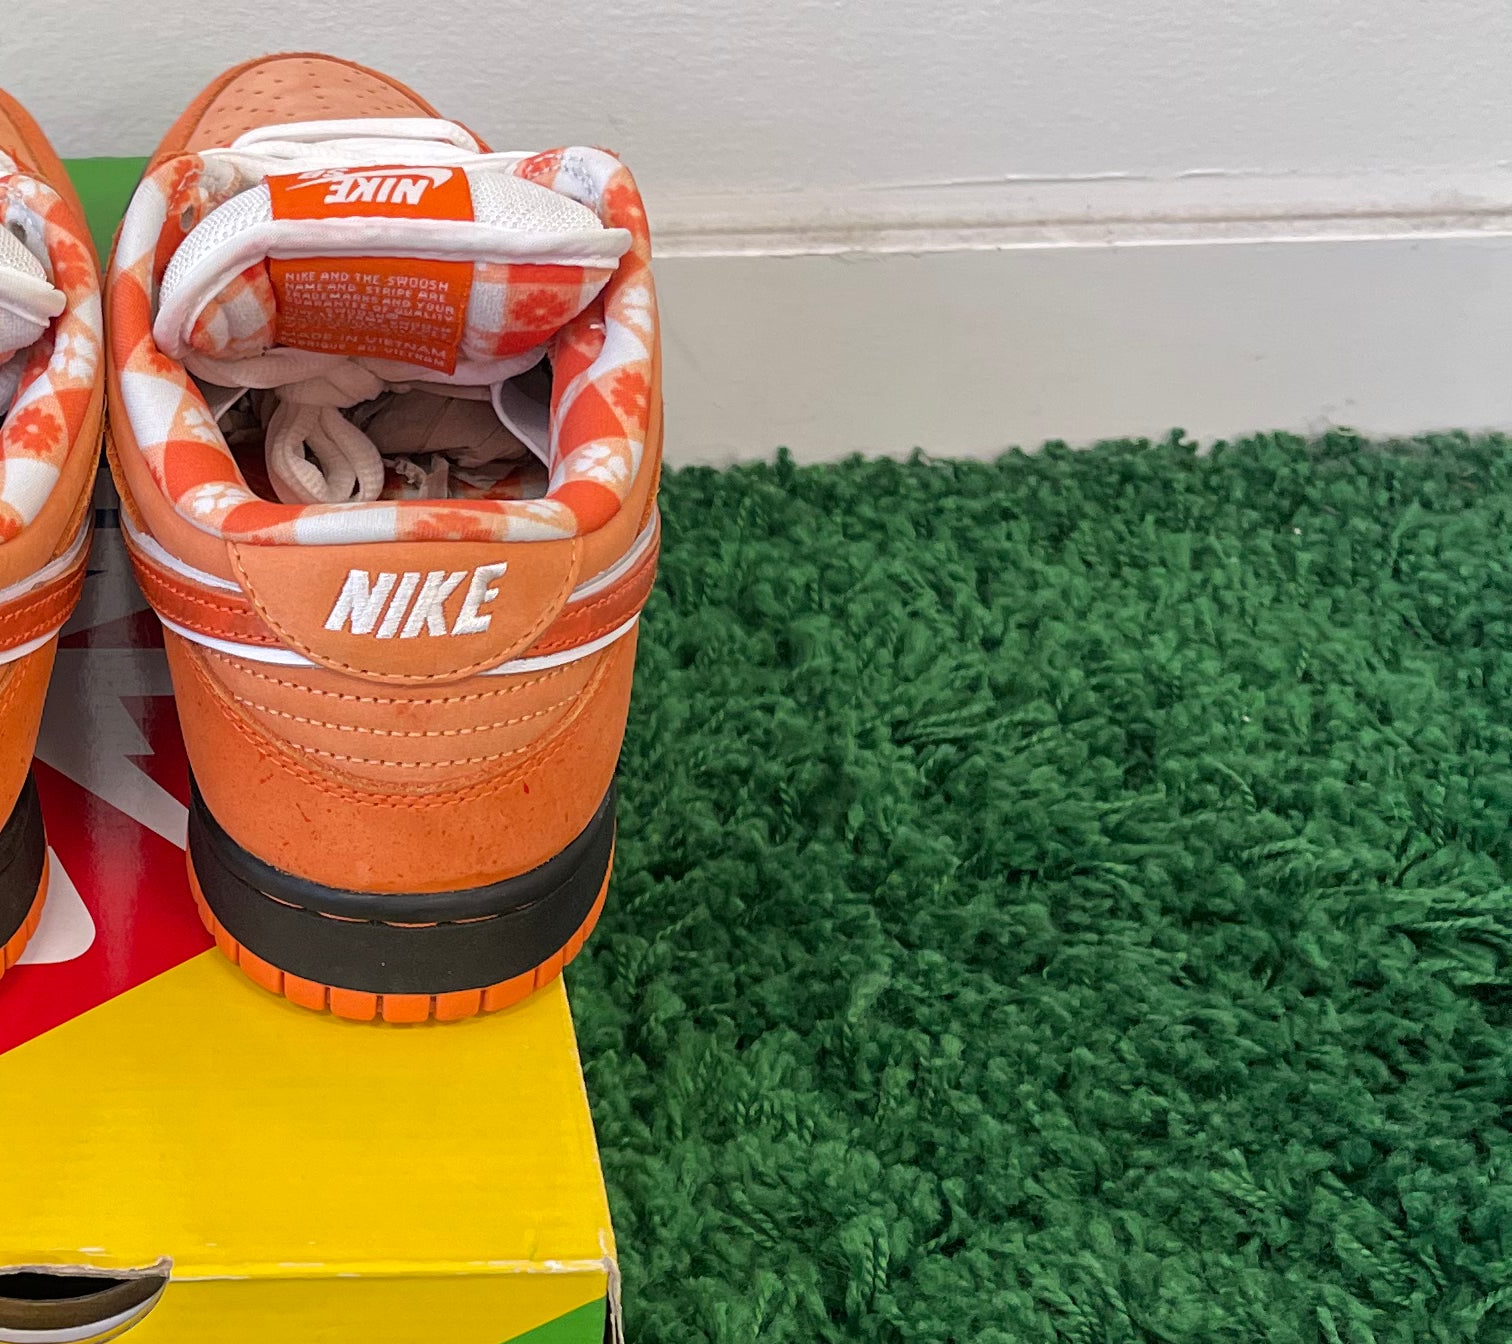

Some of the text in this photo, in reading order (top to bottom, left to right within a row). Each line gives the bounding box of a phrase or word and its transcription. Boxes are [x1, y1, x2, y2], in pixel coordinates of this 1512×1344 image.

[324, 177, 428, 205] NIKE
[285, 271, 449, 291] NIKE AND THE SWOOSH
[285, 282, 322, 291] NAME
[417, 290, 446, 303] ARE
[416, 301, 455, 315] YOUR
[324, 562, 508, 639] NIKE
